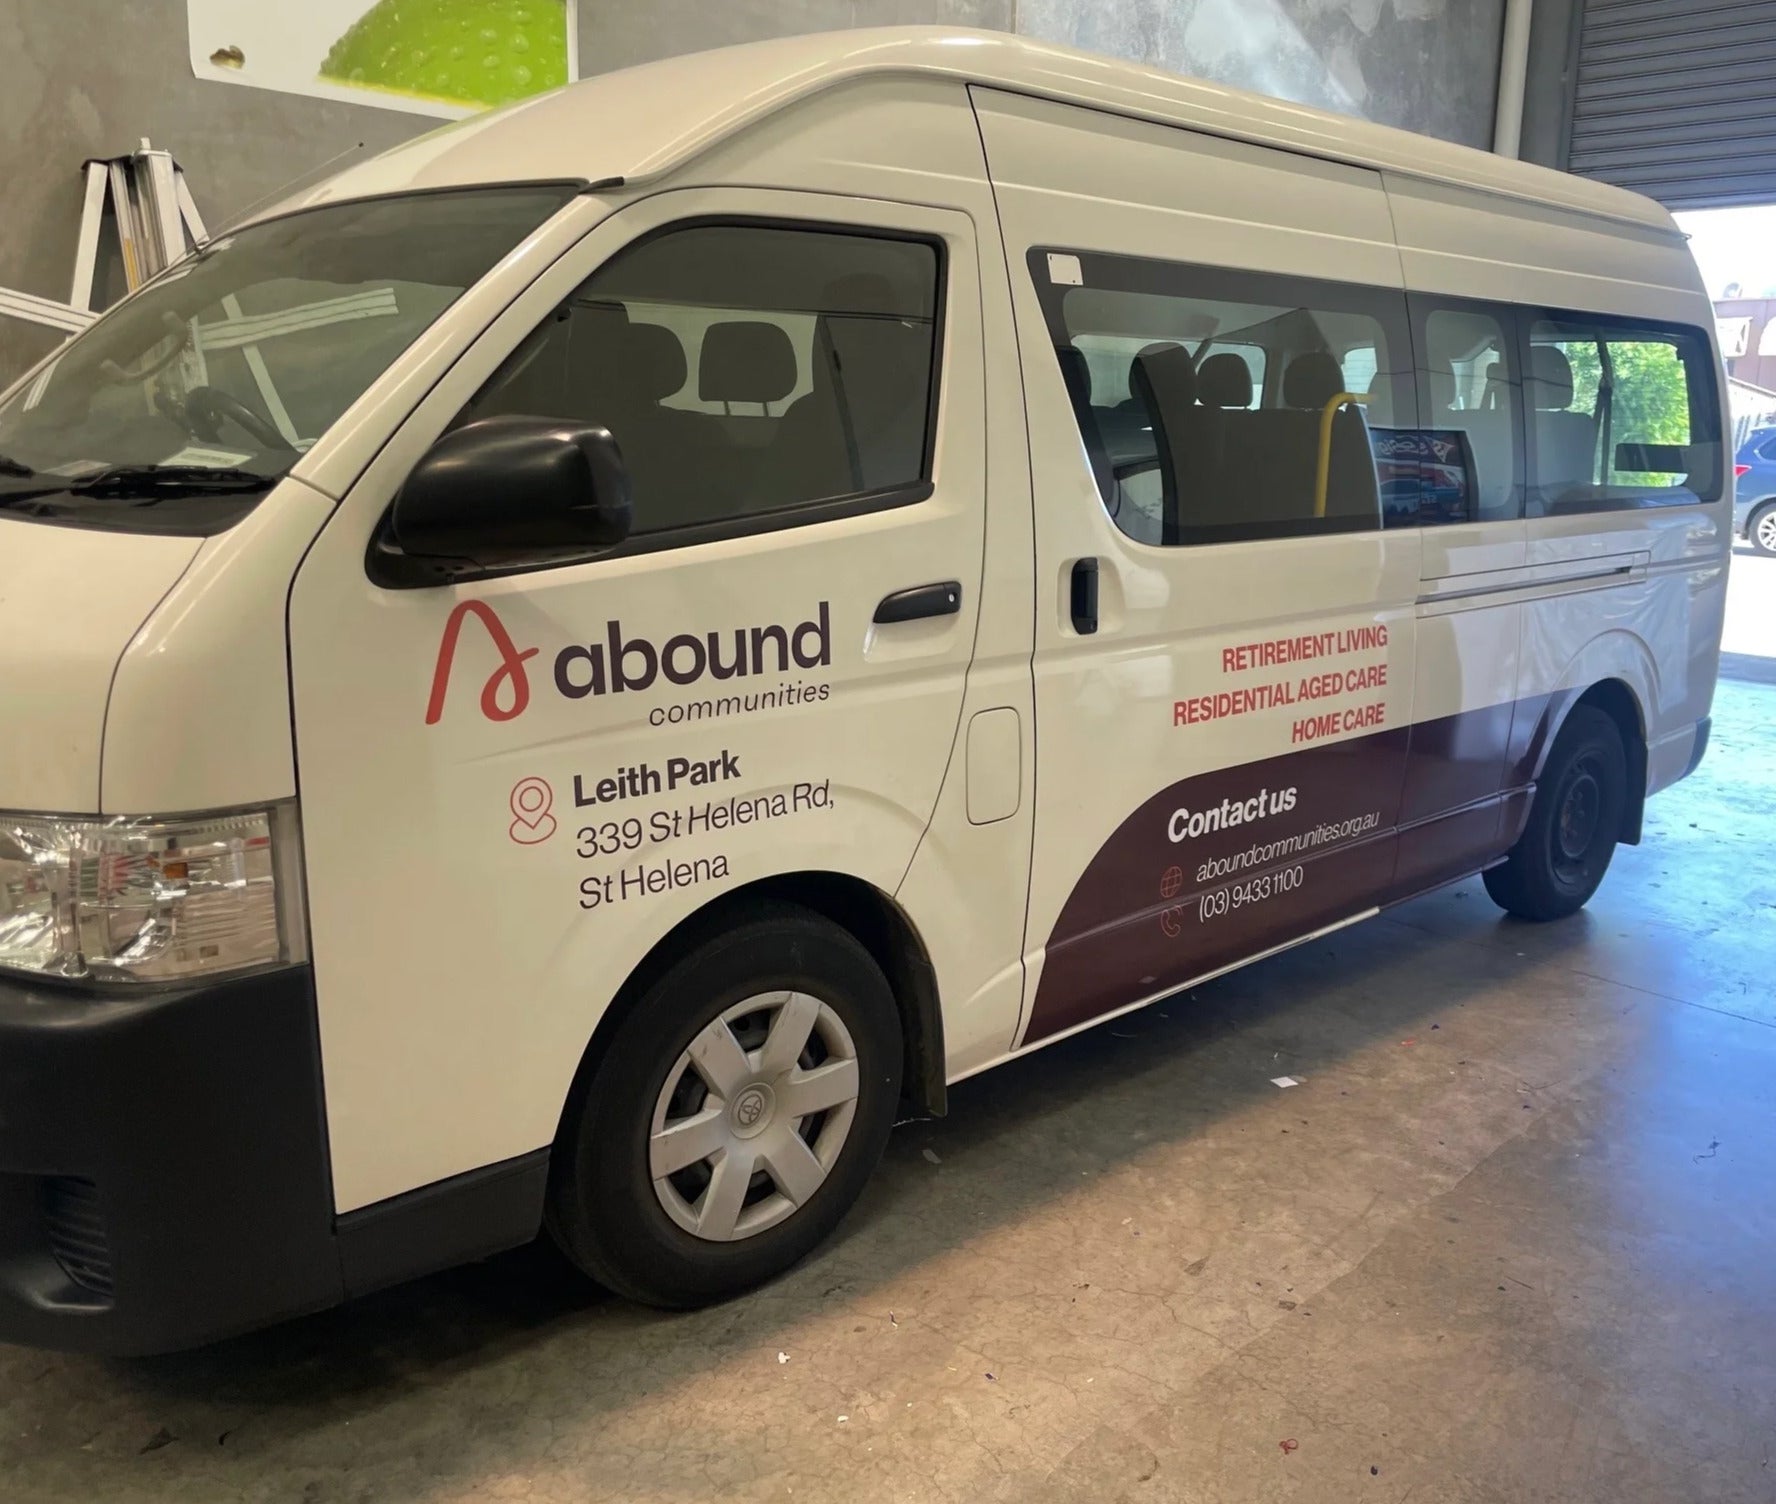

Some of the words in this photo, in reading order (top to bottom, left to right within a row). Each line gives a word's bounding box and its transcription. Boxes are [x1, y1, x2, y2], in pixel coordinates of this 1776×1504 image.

[554, 601, 831, 700] abound
[1222, 632, 1334, 672] RETIREMENT
[1337, 625, 1387, 654] LIVING
[649, 681, 830, 727] communities
[1173, 684, 1296, 726] RESIDENTIAL
[1297, 674, 1343, 701] AGED
[1345, 664, 1387, 693] CARE
[1292, 712, 1340, 743] HOME
[1343, 703, 1385, 728] CARE
[573, 763, 661, 808] Leith
[666, 750, 742, 790] Park
[576, 817, 643, 859] 339
[649, 809, 684, 843] St
[688, 793, 788, 835] Helena
[792, 779, 834, 813] Rd,
[1168, 788, 1268, 844] Contact
[1270, 786, 1297, 816] us
[1196, 811, 1381, 883] aboundcommunities.org.au
[579, 874, 614, 909] St
[620, 856, 730, 901] Helena
[1199, 888, 1231, 923] (03)
[1232, 876, 1271, 909] 9433
[1273, 865, 1304, 895] 1100
